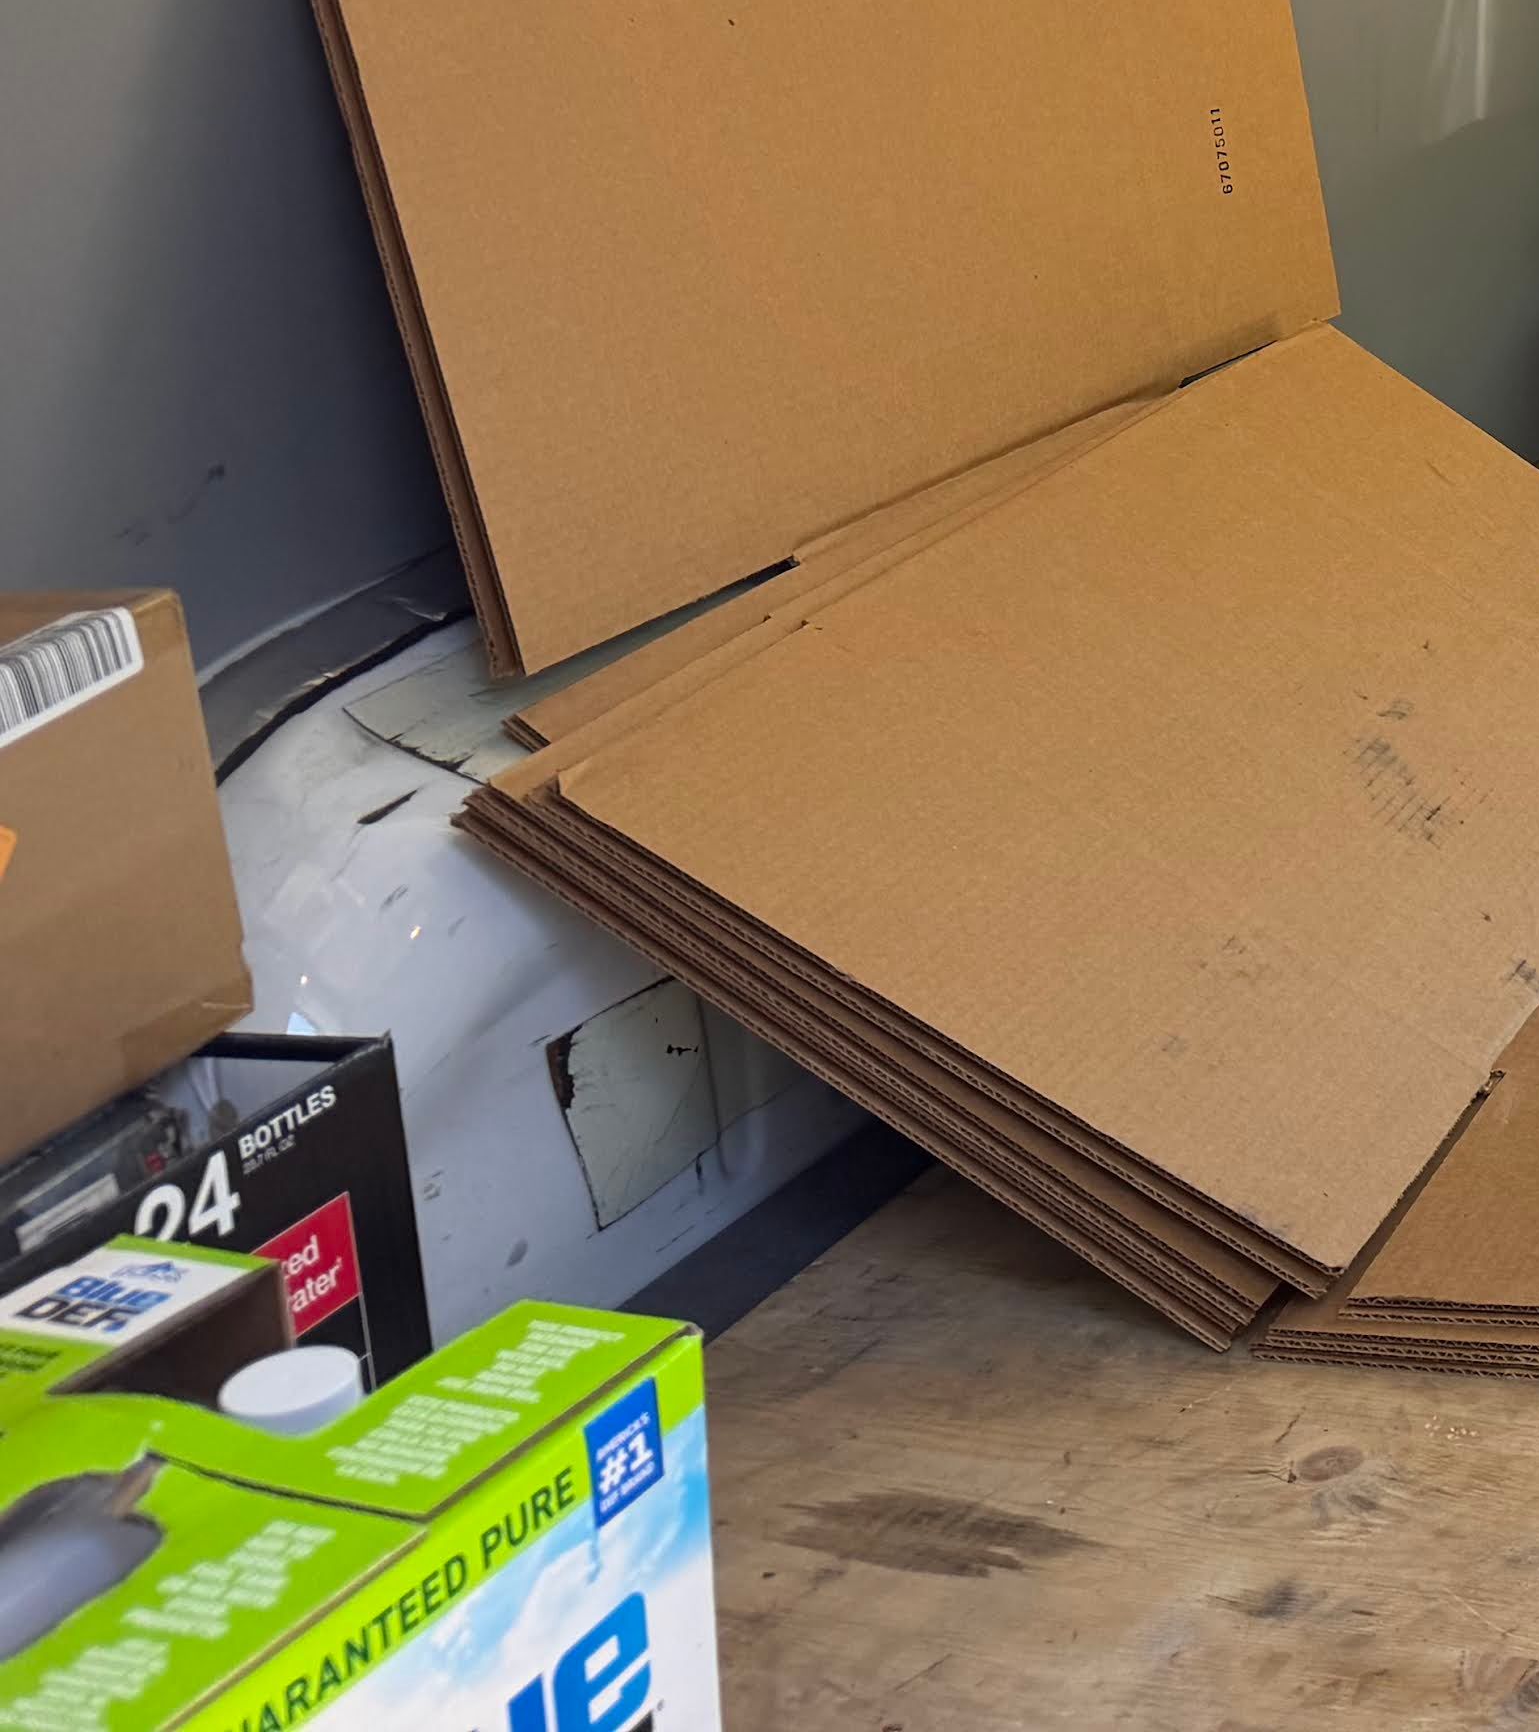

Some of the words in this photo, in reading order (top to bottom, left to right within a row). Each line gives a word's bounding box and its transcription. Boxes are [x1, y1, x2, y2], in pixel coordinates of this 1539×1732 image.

[1210, 108, 1234, 194] 67075011
[237, 1085, 337, 1161] BOTTLES
[134, 1150, 240, 1243] 24
[14, 1296, 142, 1332] DEF
[56, 1275, 173, 1310] Blue
[288, 1264, 340, 1312] ater
[599, 1431, 654, 1495] #1
[480, 1466, 577, 1570] PURE
